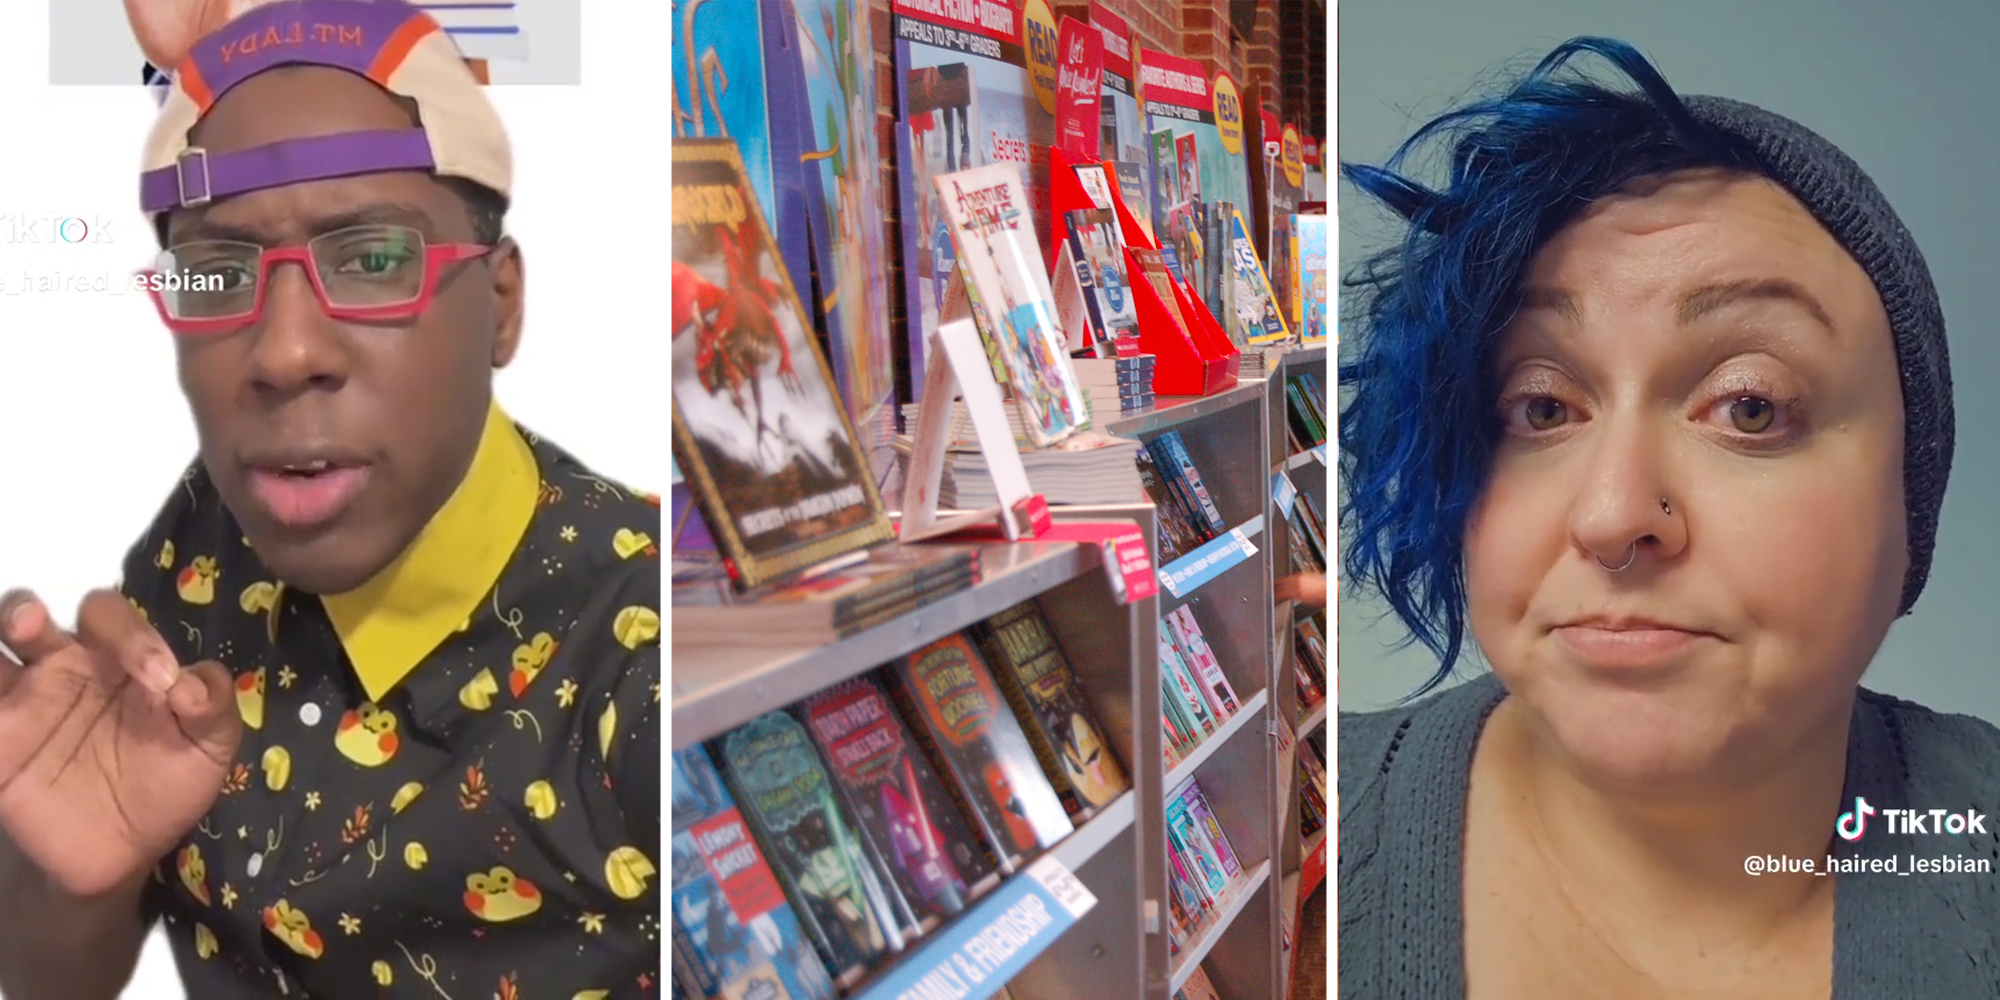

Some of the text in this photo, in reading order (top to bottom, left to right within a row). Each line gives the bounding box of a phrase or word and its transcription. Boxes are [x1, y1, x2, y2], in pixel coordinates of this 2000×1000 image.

[900, 18, 933, 43] APPEALS
[932, 26, 945, 46] TO
[969, 34, 1001, 58] GRADERS
[1027, 18, 1057, 68] READ
[1216, 91, 1239, 123] READ
[992, 130, 1026, 163] Secrets
[953, 180, 1010, 213] ADVENTURE
[967, 201, 1019, 237] TIME
[926, 663, 976, 701] FORTUNE
[844, 693, 886, 728] PAPER
[864, 727, 895, 753] BACK
[699, 822, 746, 857] LEMONY
[712, 842, 759, 881] SNICKET
[896, 893, 1054, 1000] MILY & FRIENDSHIP
